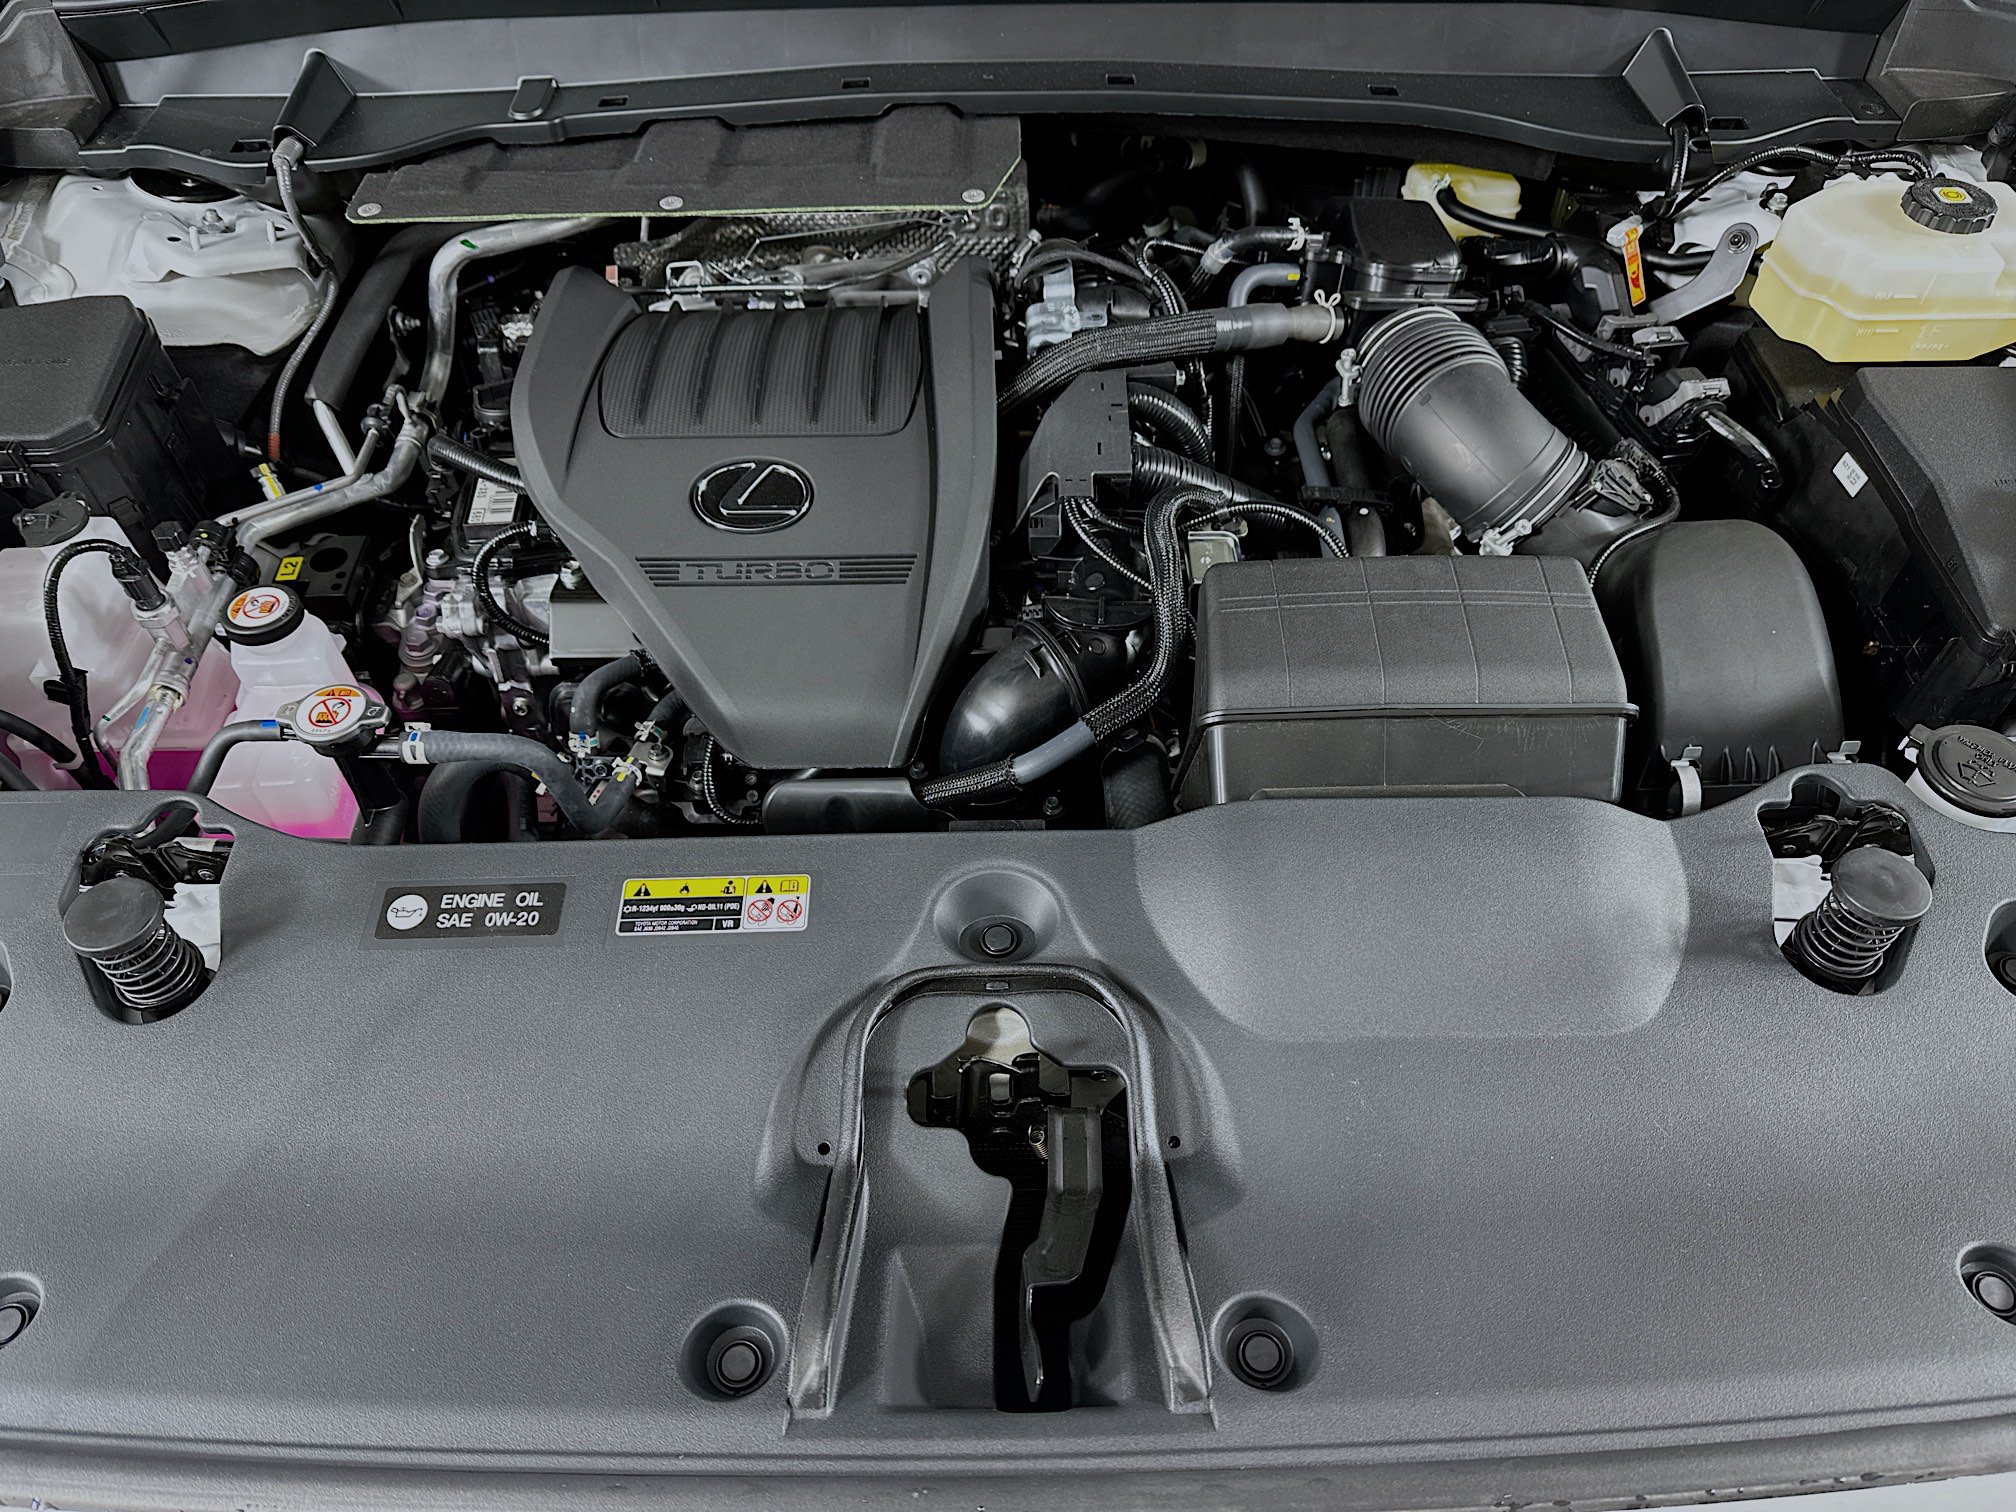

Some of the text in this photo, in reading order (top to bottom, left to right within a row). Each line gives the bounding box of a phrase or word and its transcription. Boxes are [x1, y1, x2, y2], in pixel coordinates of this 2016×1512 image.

[280, 561, 299, 577] L2
[685, 560, 835, 580] TURBO
[440, 891, 544, 909] ENGINE OIL
[436, 911, 540, 929] SAE 0W-20
[722, 919, 735, 928] VR
